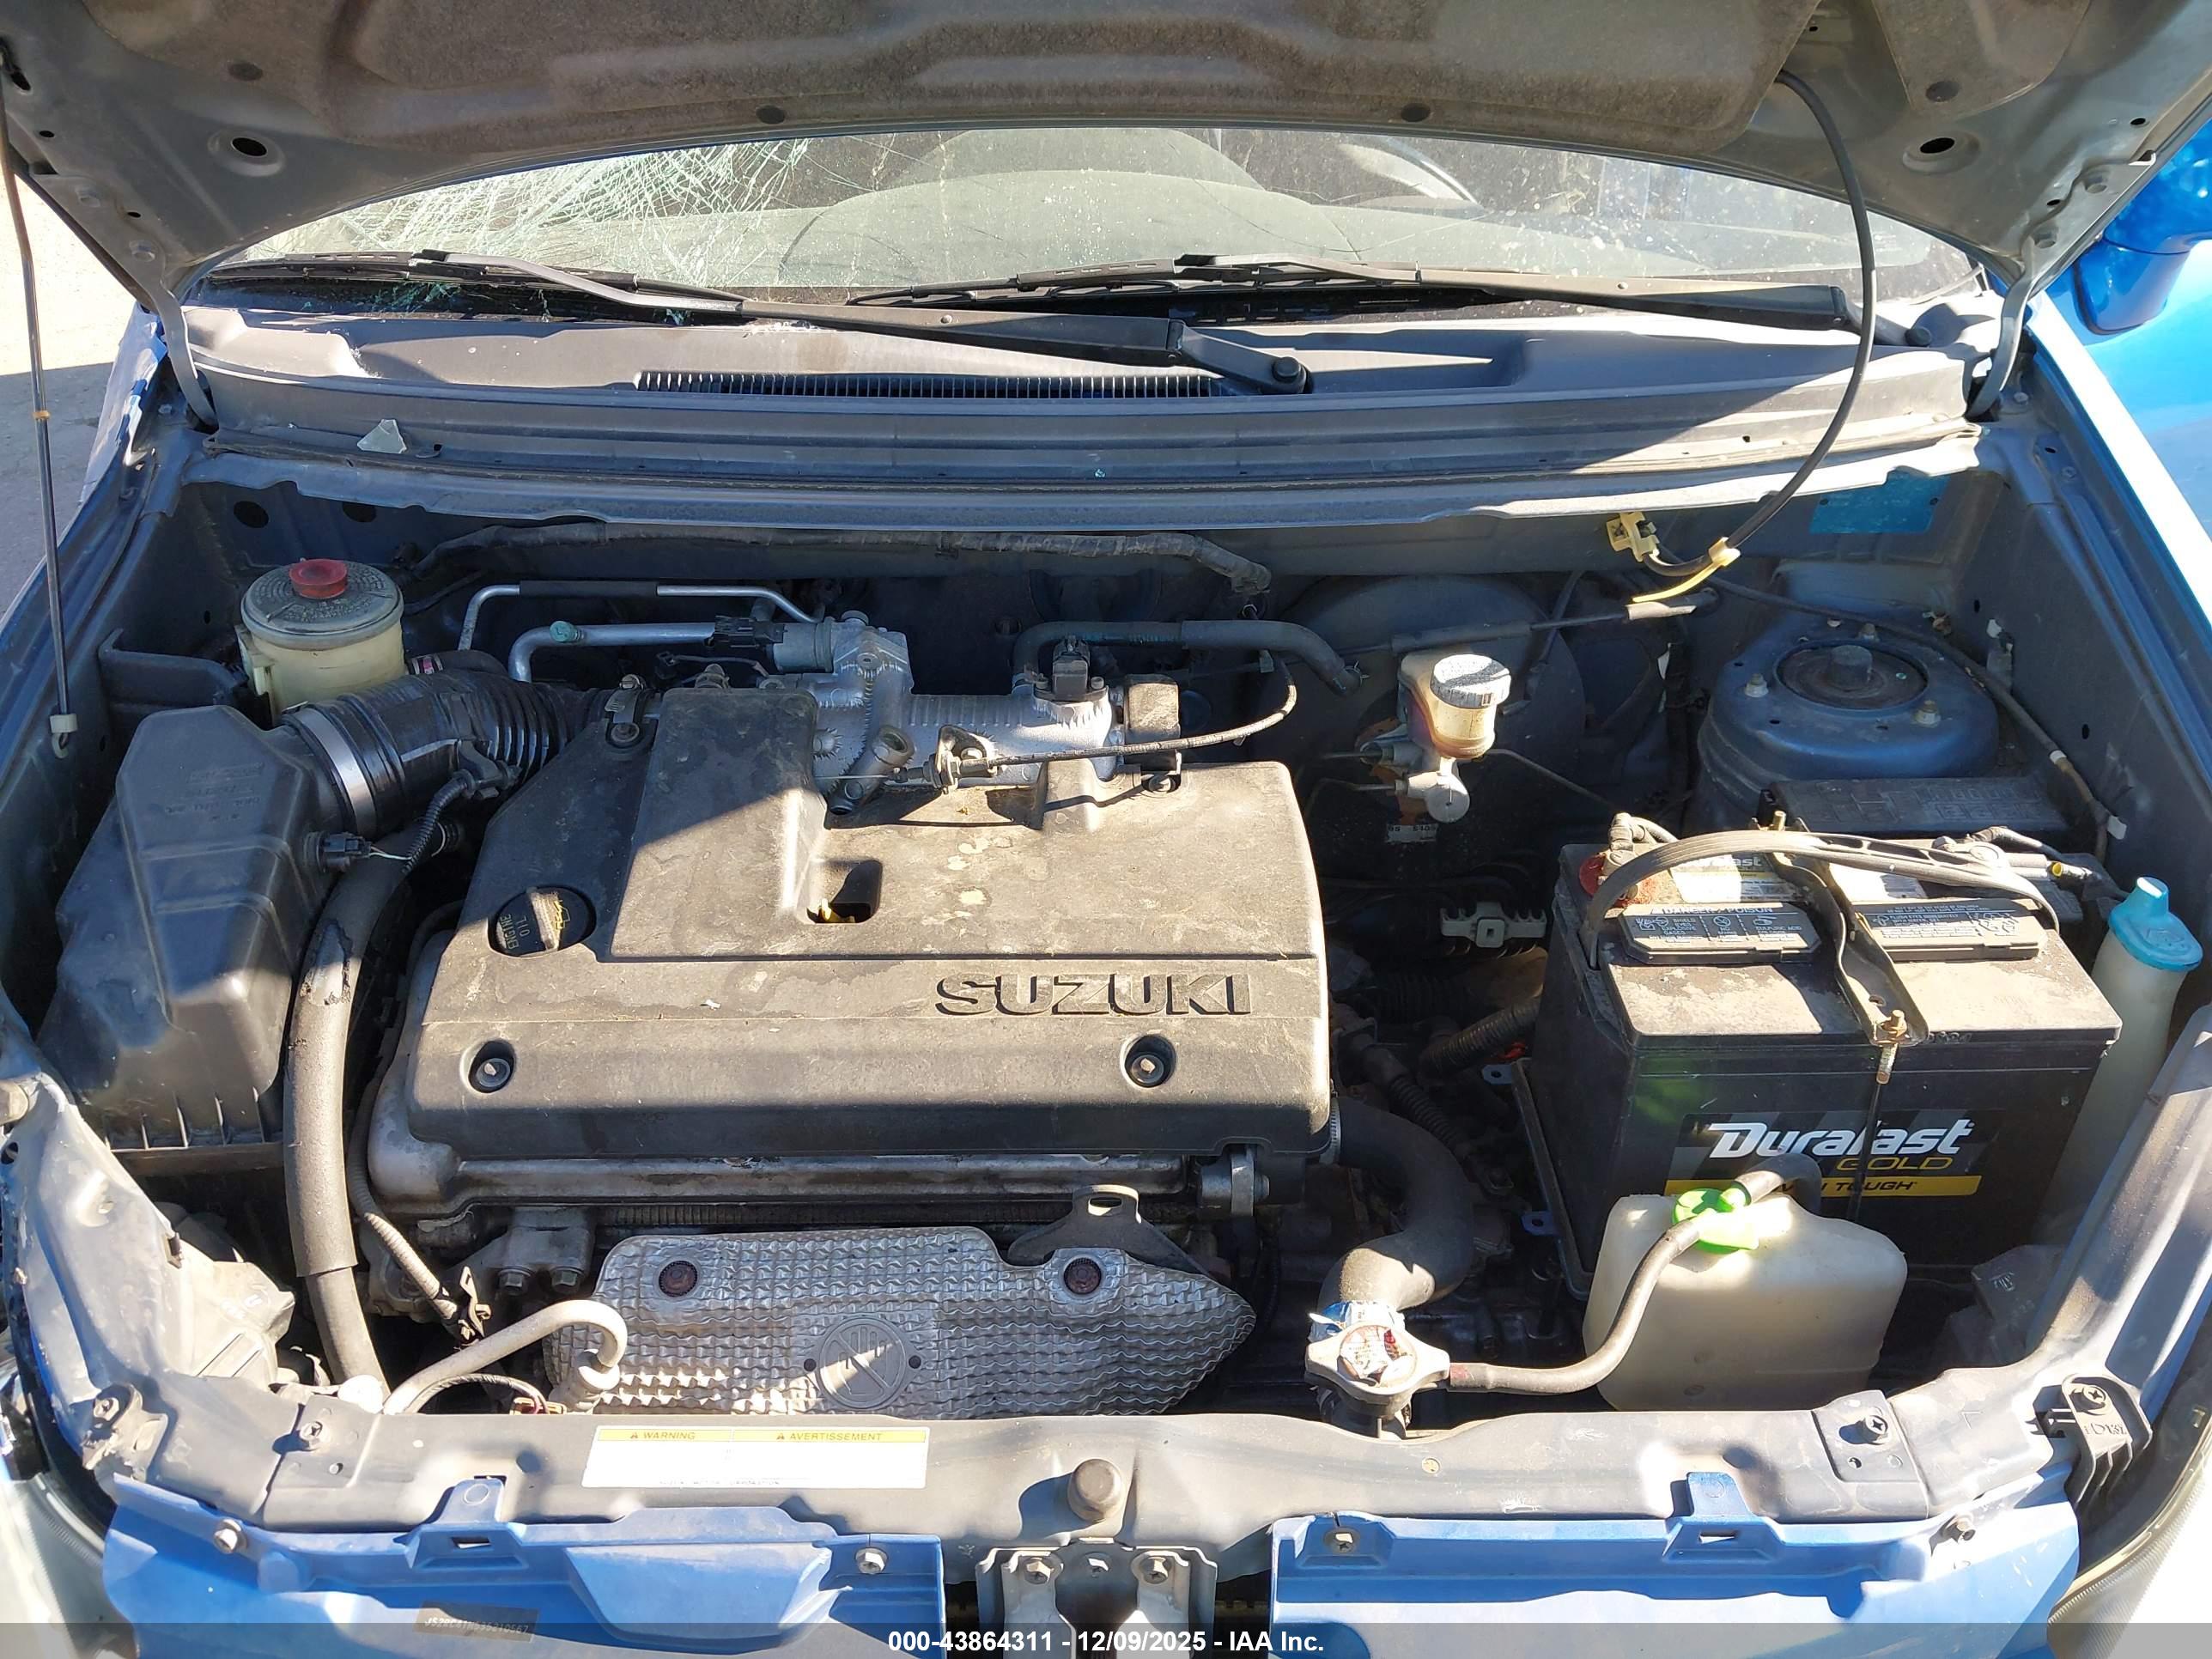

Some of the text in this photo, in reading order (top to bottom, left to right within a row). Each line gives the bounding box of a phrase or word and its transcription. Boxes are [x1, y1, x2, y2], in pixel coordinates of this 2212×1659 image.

[500, 913, 520, 950] ENGINE
[515, 915, 531, 937] OIL
[935, 973, 1251, 1016] SUZUKI
[1837, 1157, 1953, 1170] GOLD
[643, 1431, 696, 1440] WARNING
[789, 1431, 883, 1441] AVERTISSEMENT
